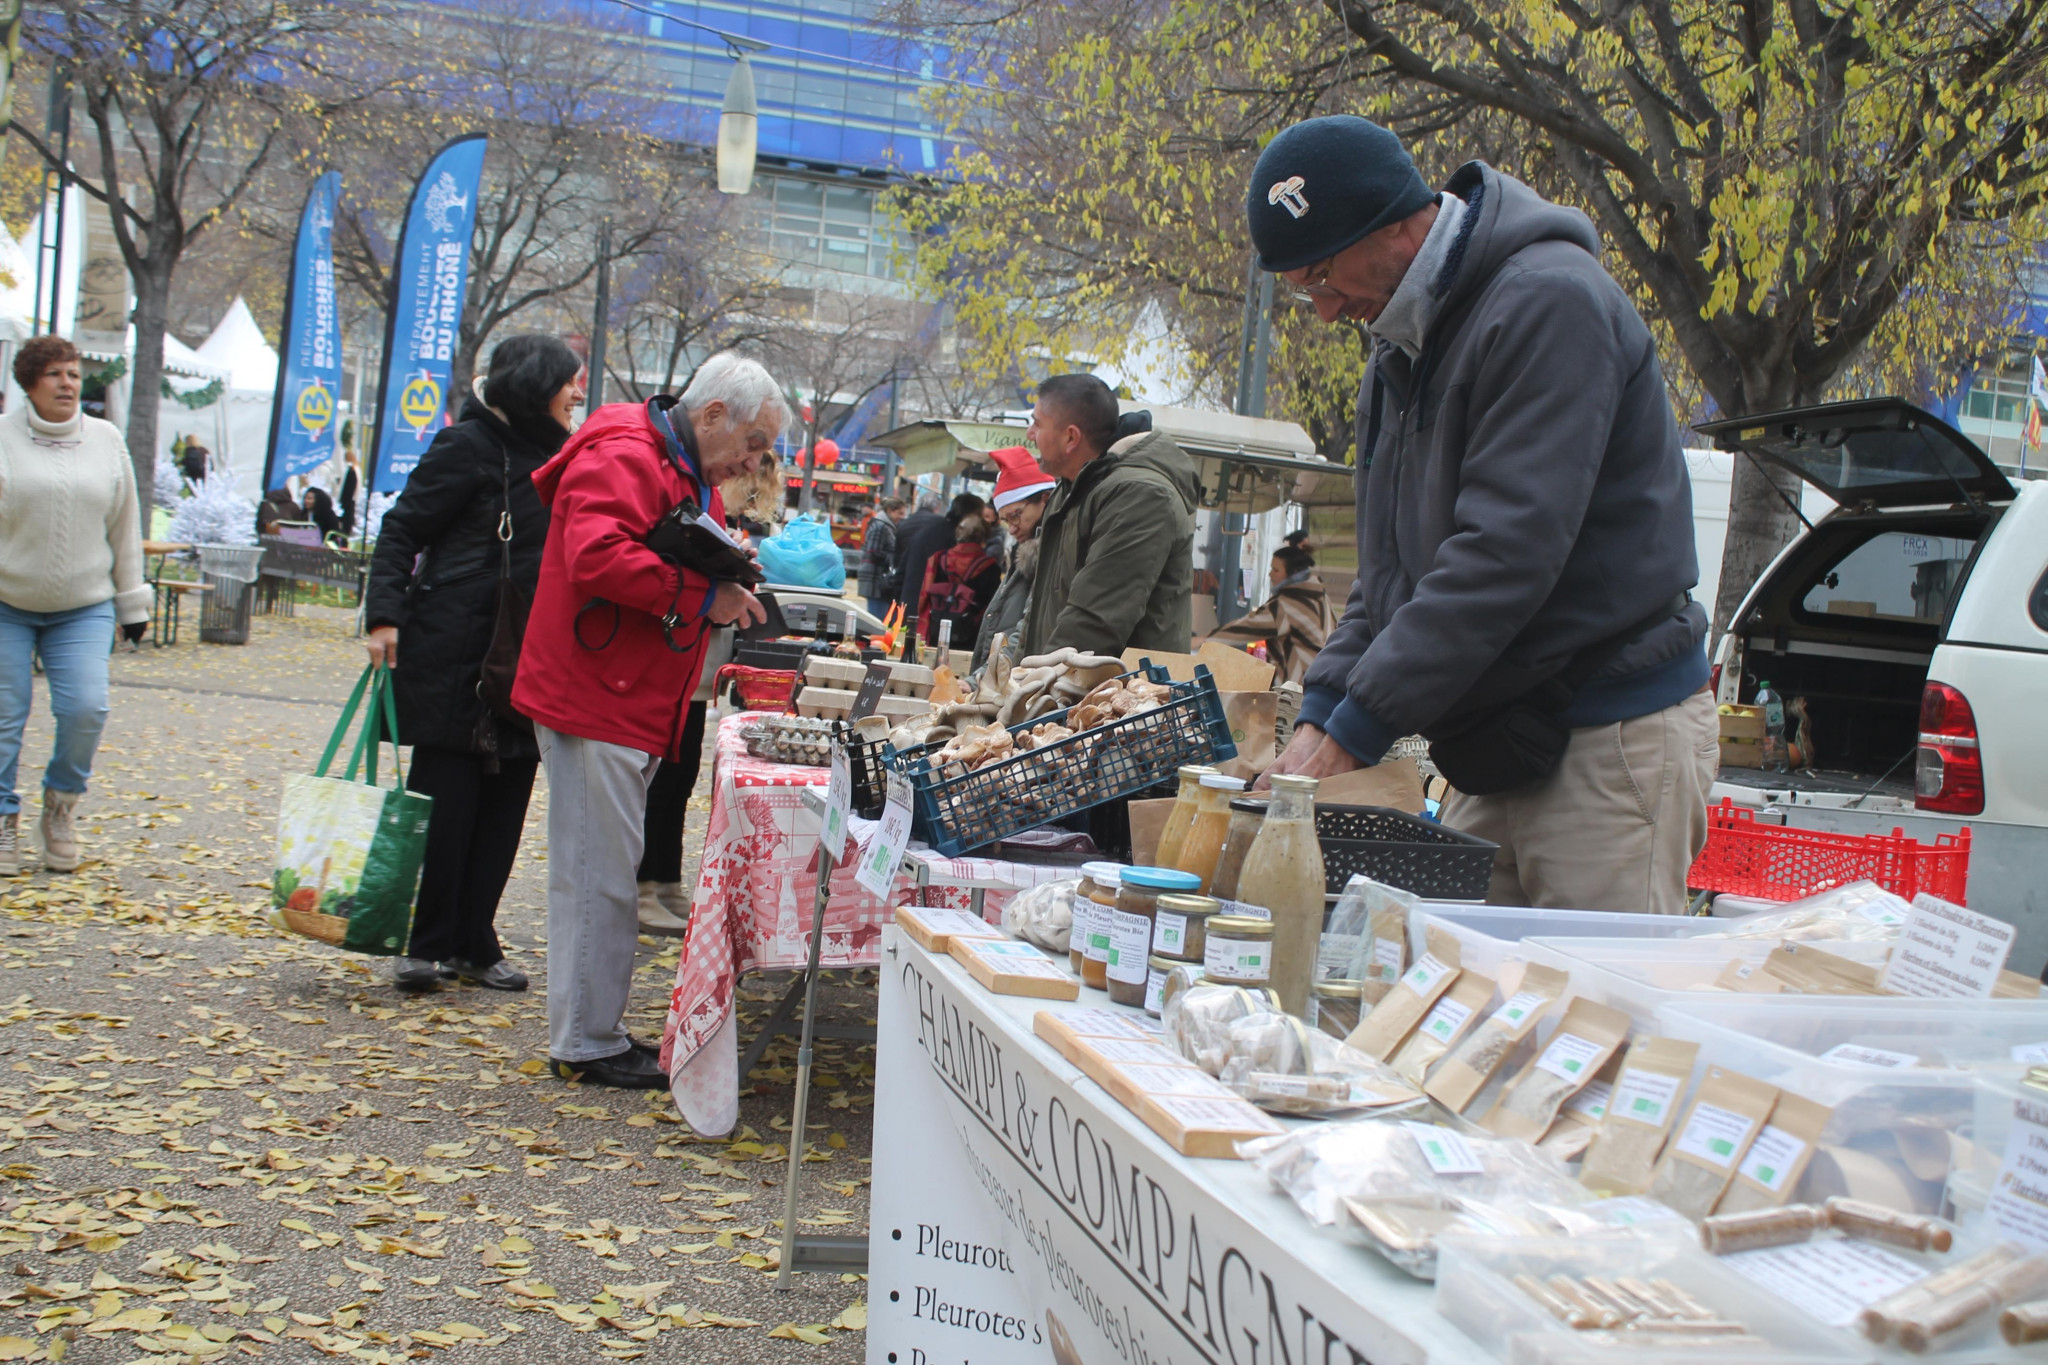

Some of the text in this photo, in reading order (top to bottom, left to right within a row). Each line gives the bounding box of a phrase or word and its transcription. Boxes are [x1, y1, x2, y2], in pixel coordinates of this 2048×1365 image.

[1903, 536, 1928, 551] FRCX
[1015, 1070, 1043, 1172] &
[1049, 1096, 1374, 1365] COMPAG
[912, 1285, 1026, 1342] Pleurotes
